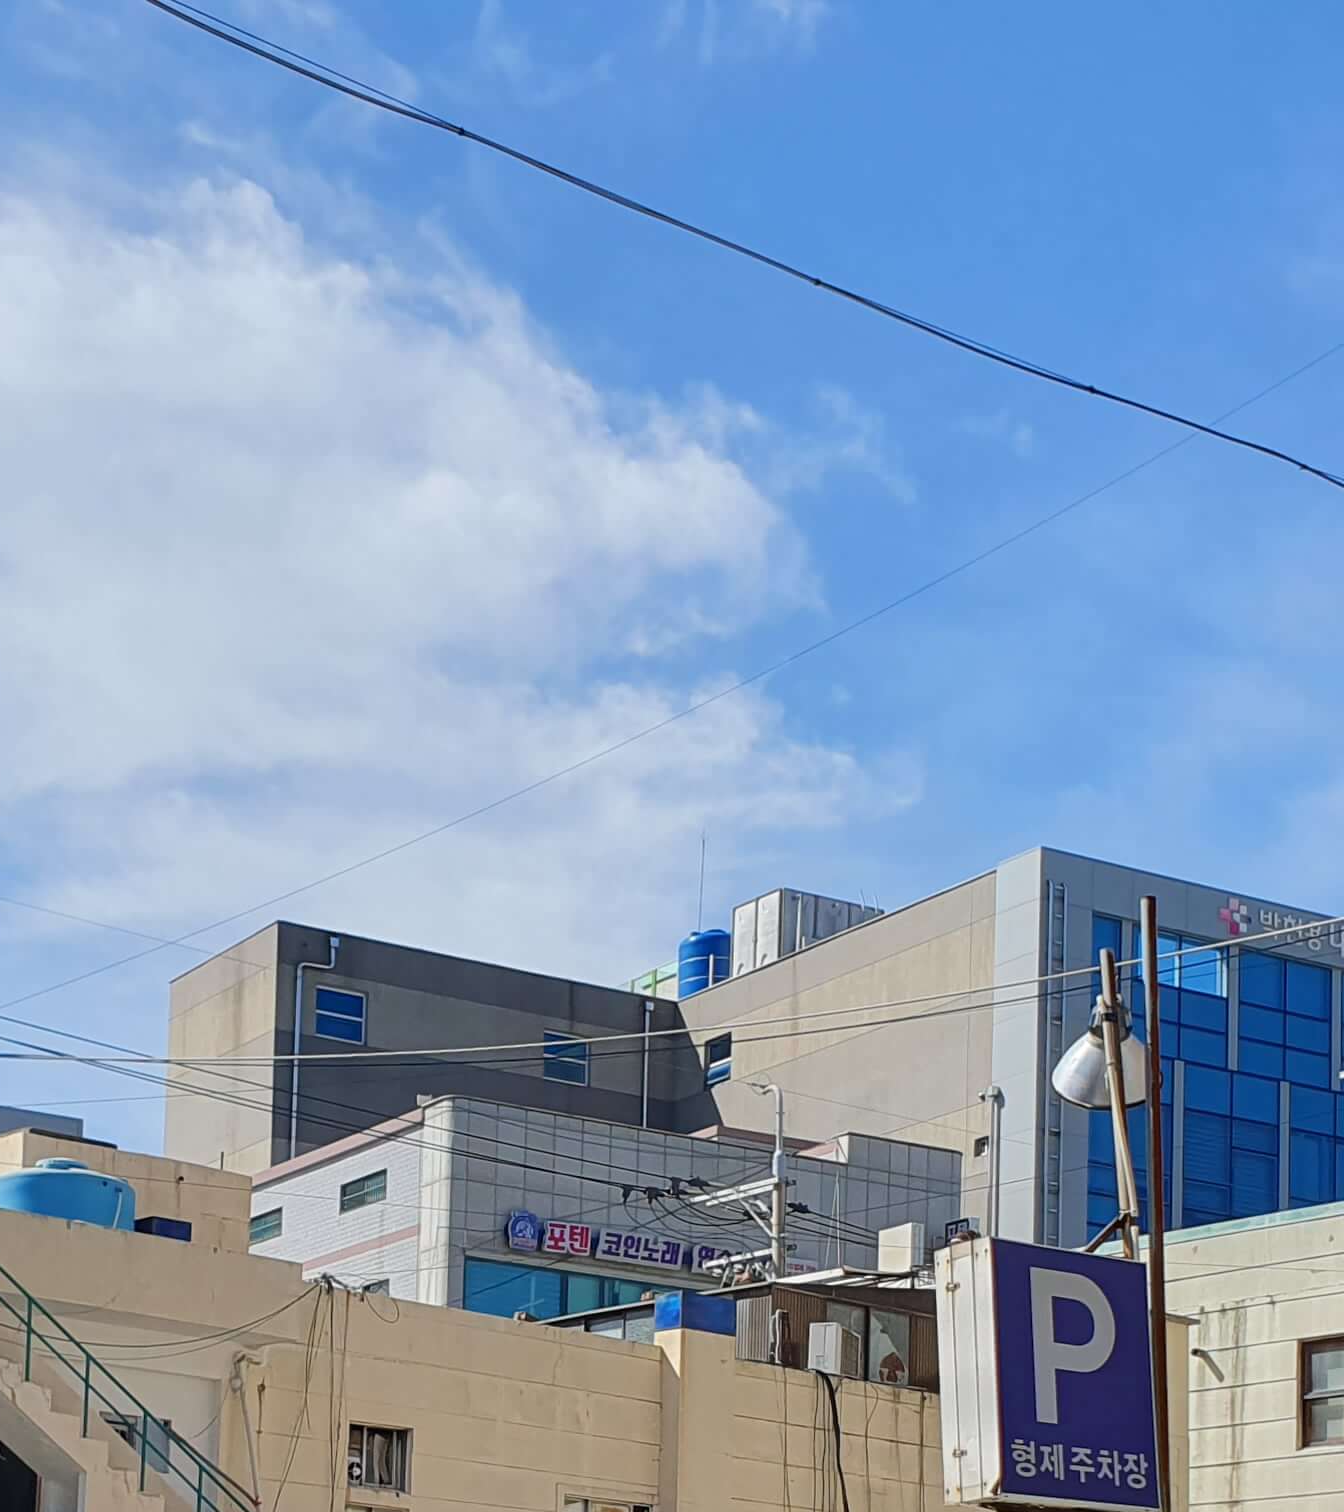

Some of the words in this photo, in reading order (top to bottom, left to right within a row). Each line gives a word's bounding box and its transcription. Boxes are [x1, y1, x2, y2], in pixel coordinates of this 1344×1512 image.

[546, 1222, 590, 1254] 포텐
[601, 1231, 681, 1266] 코인노래
[1029, 1265, 1116, 1425] P
[1011, 1438, 1149, 1490] 형제주차장
